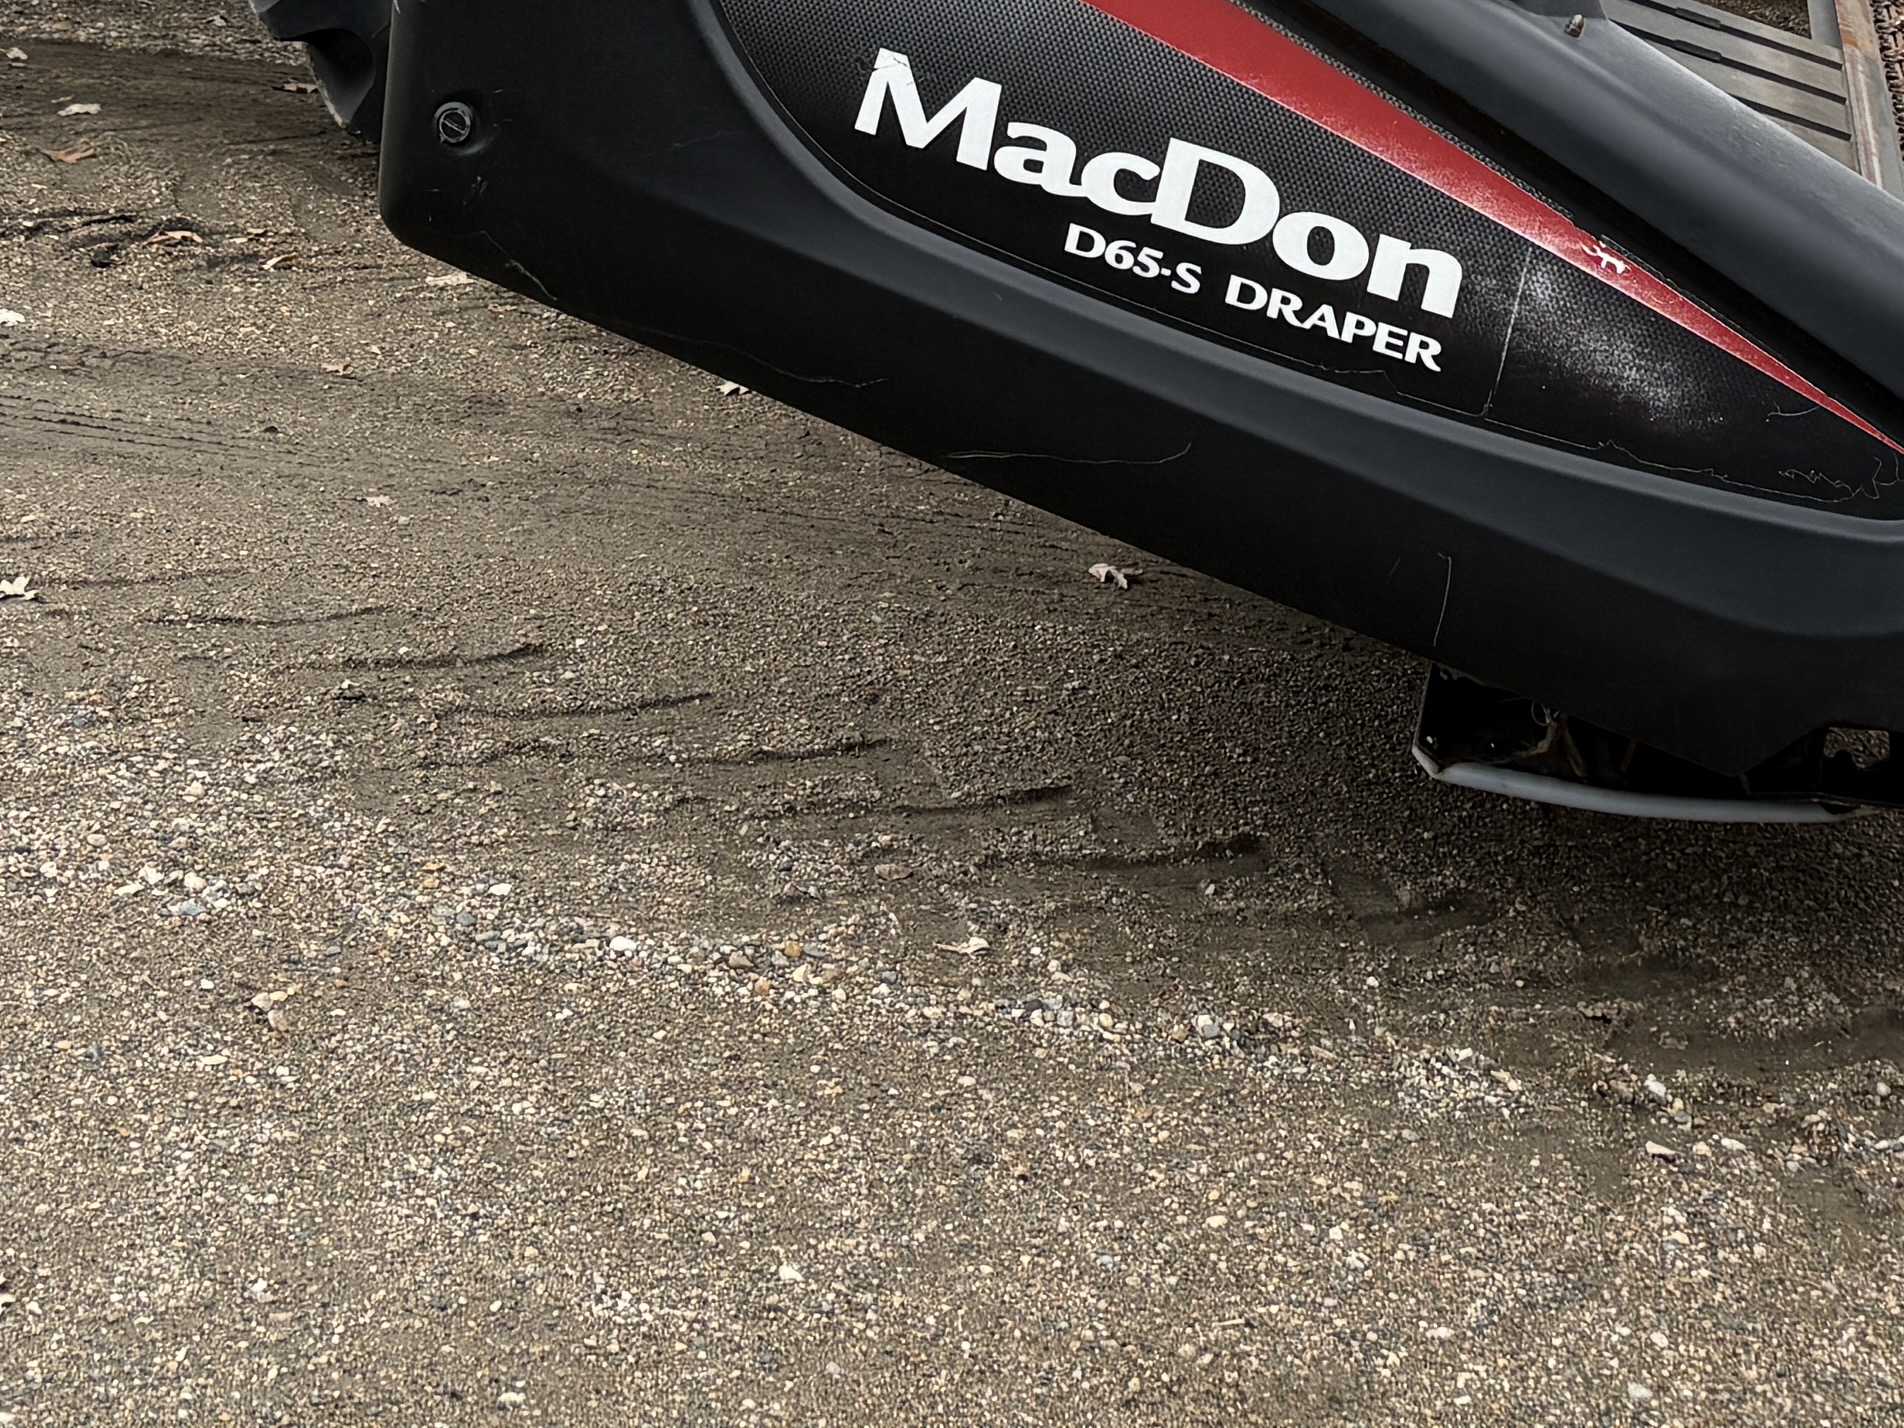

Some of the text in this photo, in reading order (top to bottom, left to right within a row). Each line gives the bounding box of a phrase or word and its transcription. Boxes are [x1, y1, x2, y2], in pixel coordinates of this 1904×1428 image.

[854, 47, 1462, 318] MacDon
[1064, 222, 1442, 373] D65-S DRAPER
